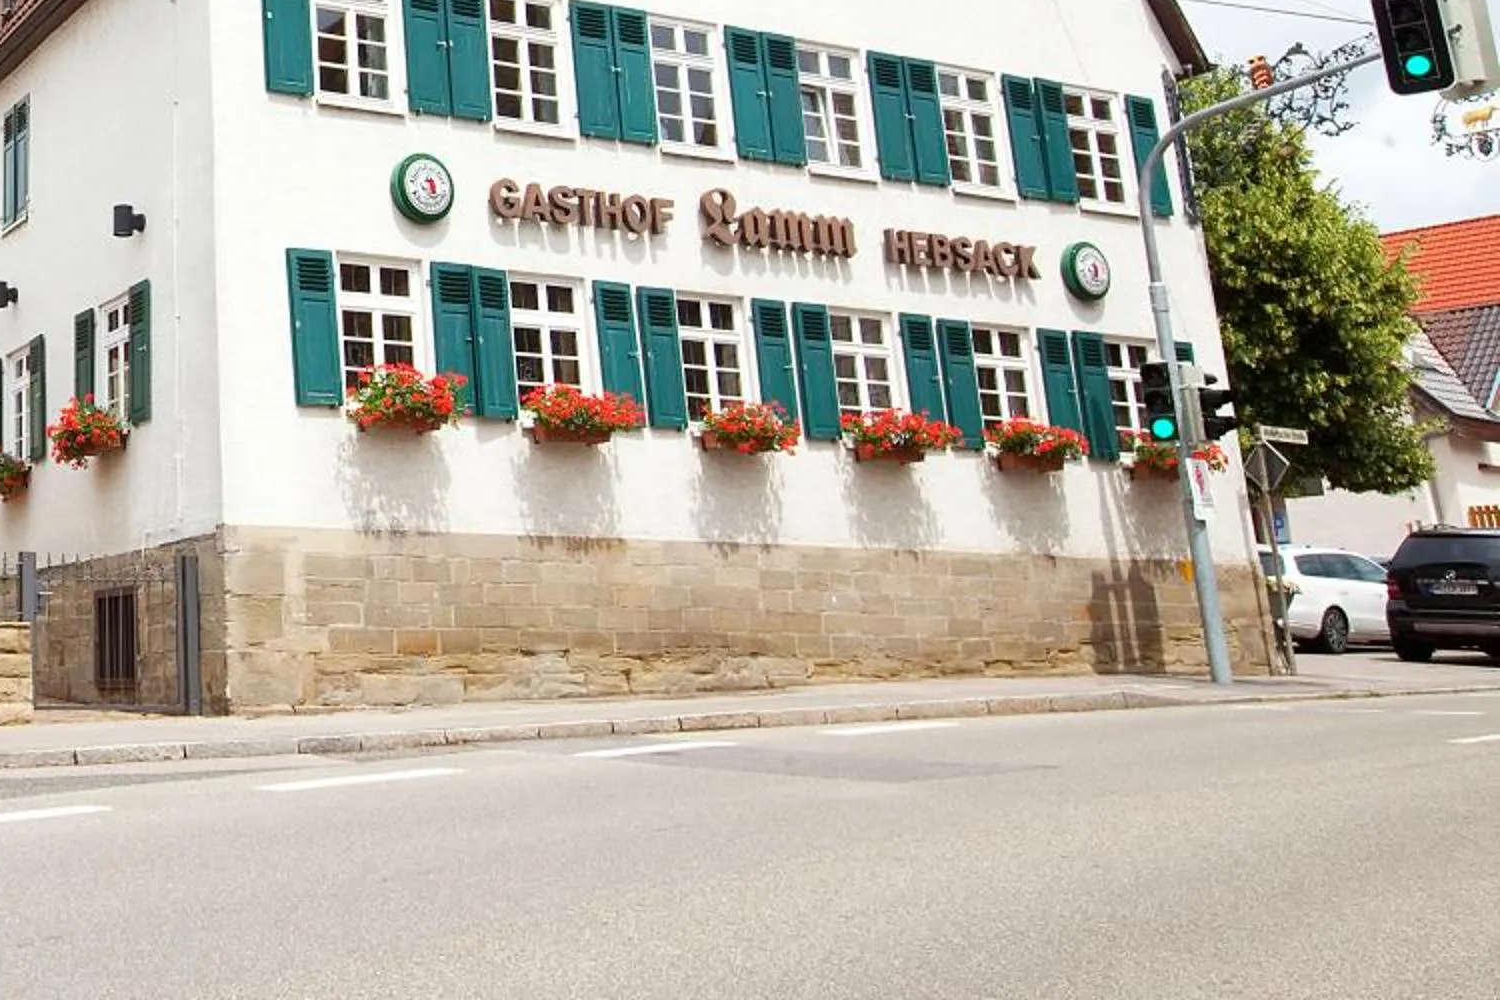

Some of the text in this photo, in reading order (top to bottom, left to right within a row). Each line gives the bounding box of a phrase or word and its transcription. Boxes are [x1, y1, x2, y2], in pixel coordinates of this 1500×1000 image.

[488, 177, 675, 235] GASTHOF
[699, 187, 858, 259] Lamm
[883, 228, 1042, 280] HEBSACK
